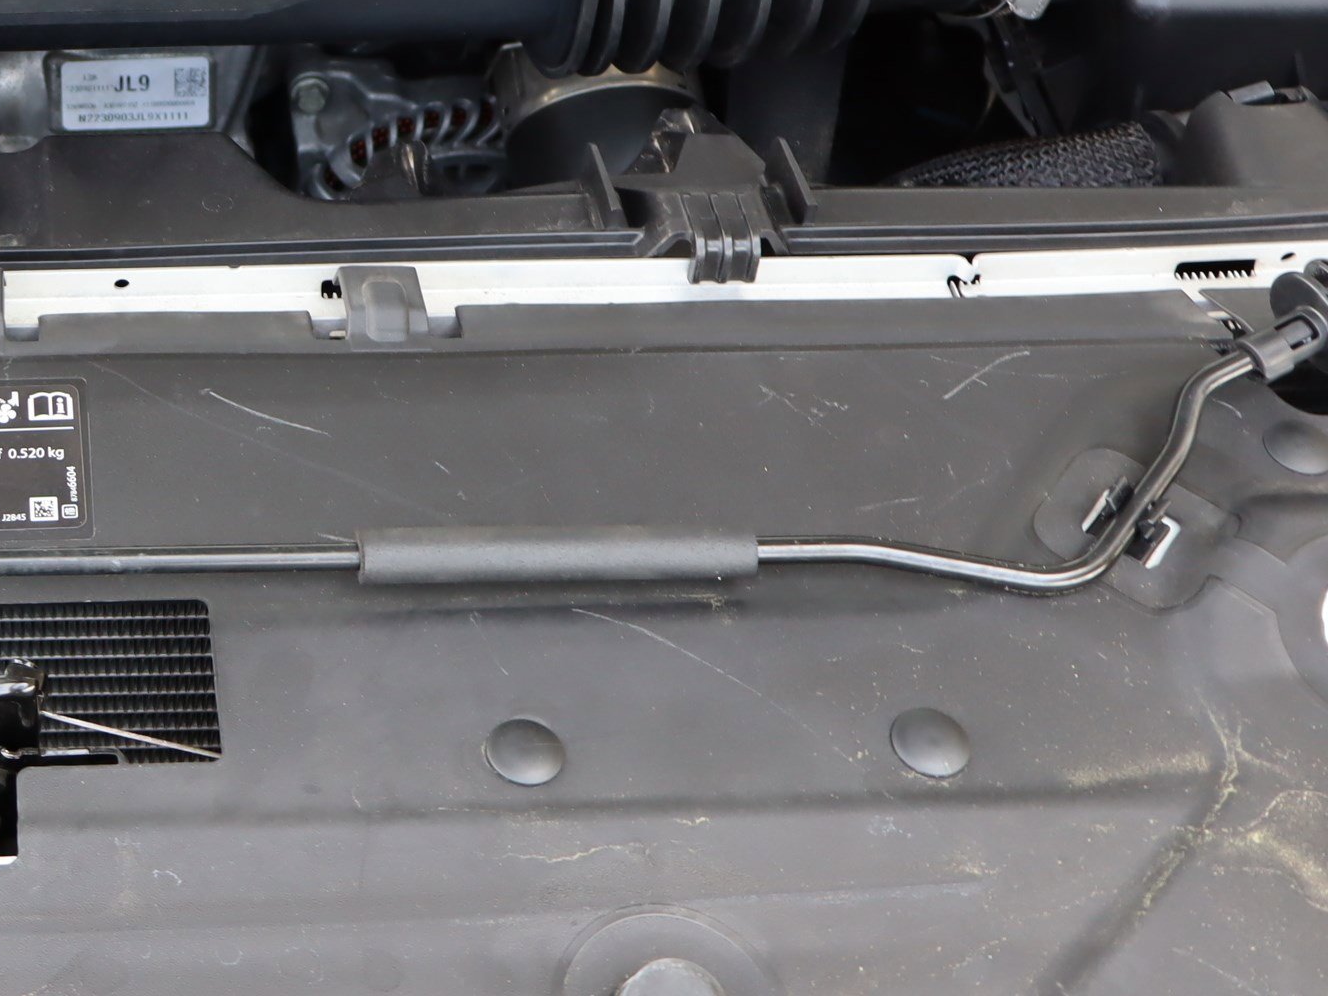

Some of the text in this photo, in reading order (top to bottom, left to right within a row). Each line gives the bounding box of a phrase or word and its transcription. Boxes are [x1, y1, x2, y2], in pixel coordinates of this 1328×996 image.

[114, 75, 150, 92] JL9
[8, 447, 45, 459] 0.520
[47, 447, 65, 460] kg
[2, 513, 26, 522] J2845
